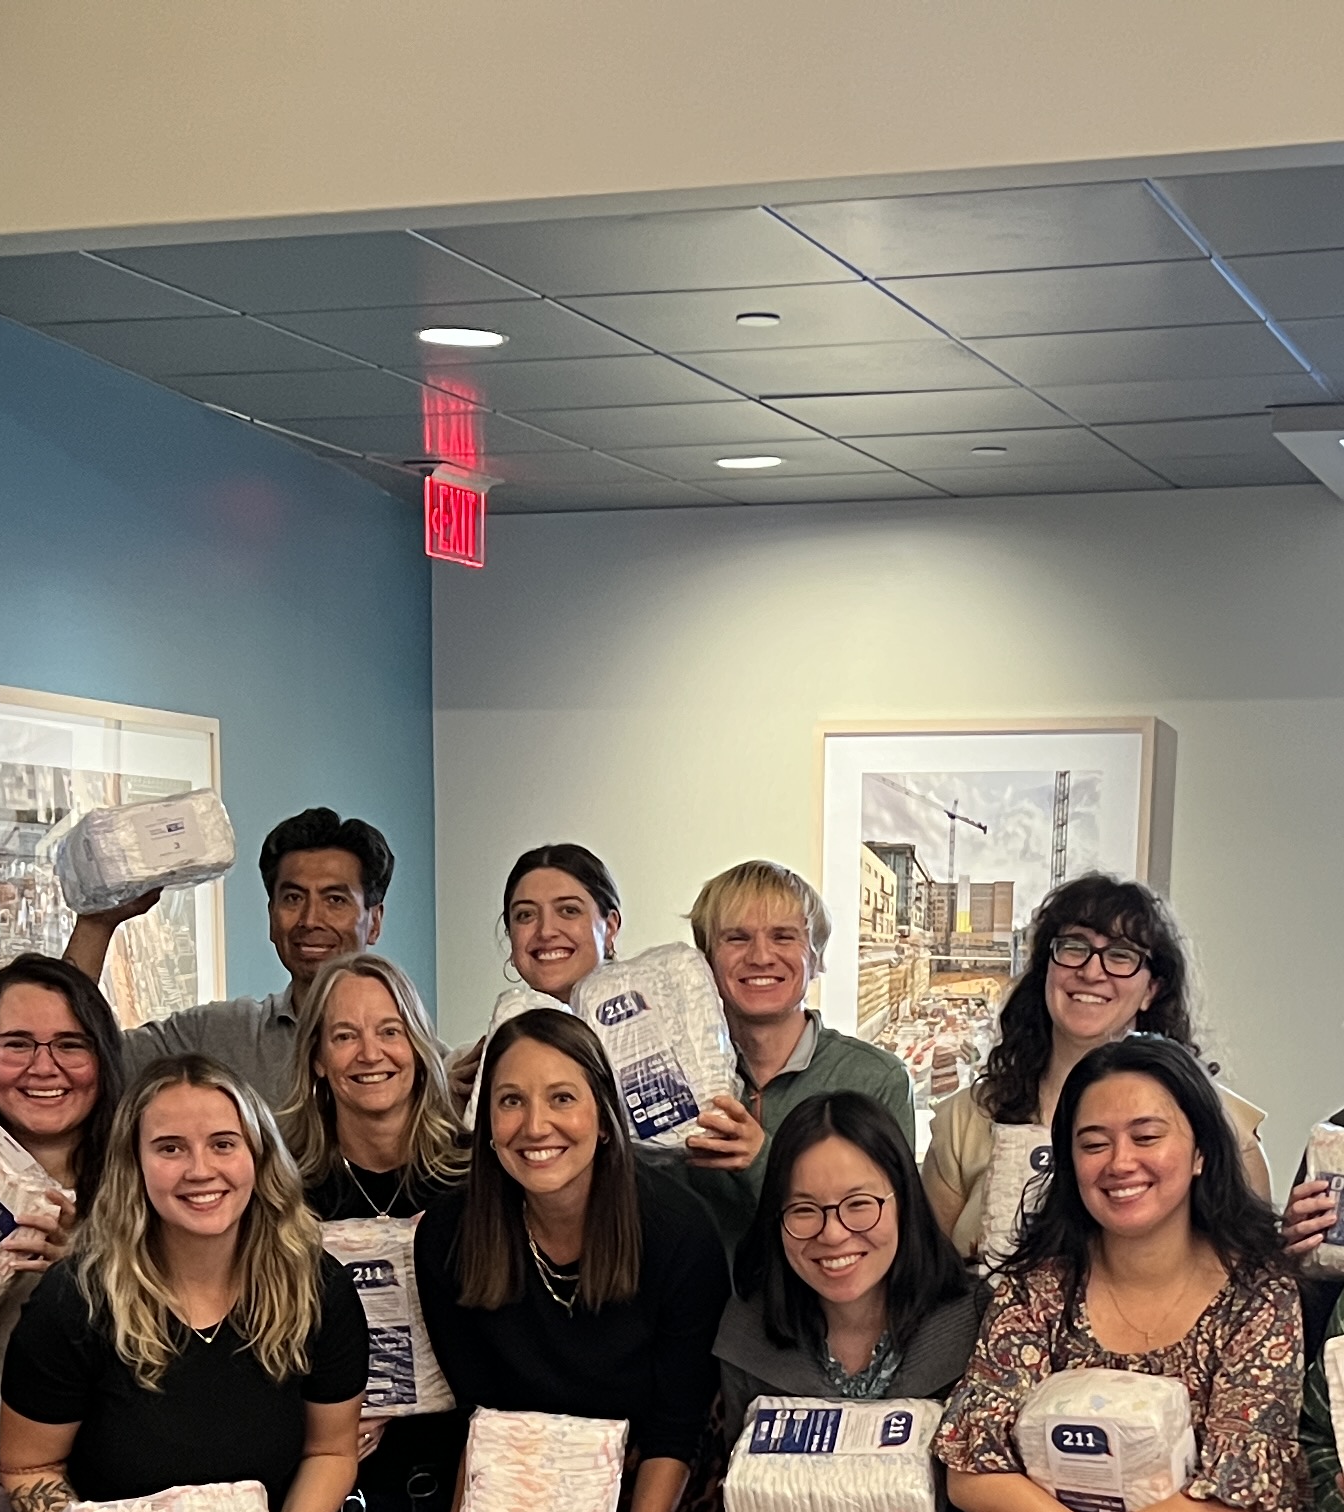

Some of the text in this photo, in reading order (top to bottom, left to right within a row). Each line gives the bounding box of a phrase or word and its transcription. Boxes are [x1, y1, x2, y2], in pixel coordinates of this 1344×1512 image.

[437, 485, 478, 558] EXIT
[605, 998, 634, 1018] 211
[352, 1266, 384, 1282] 211
[888, 1417, 906, 1439] 211
[1062, 1431, 1095, 1447] 211
